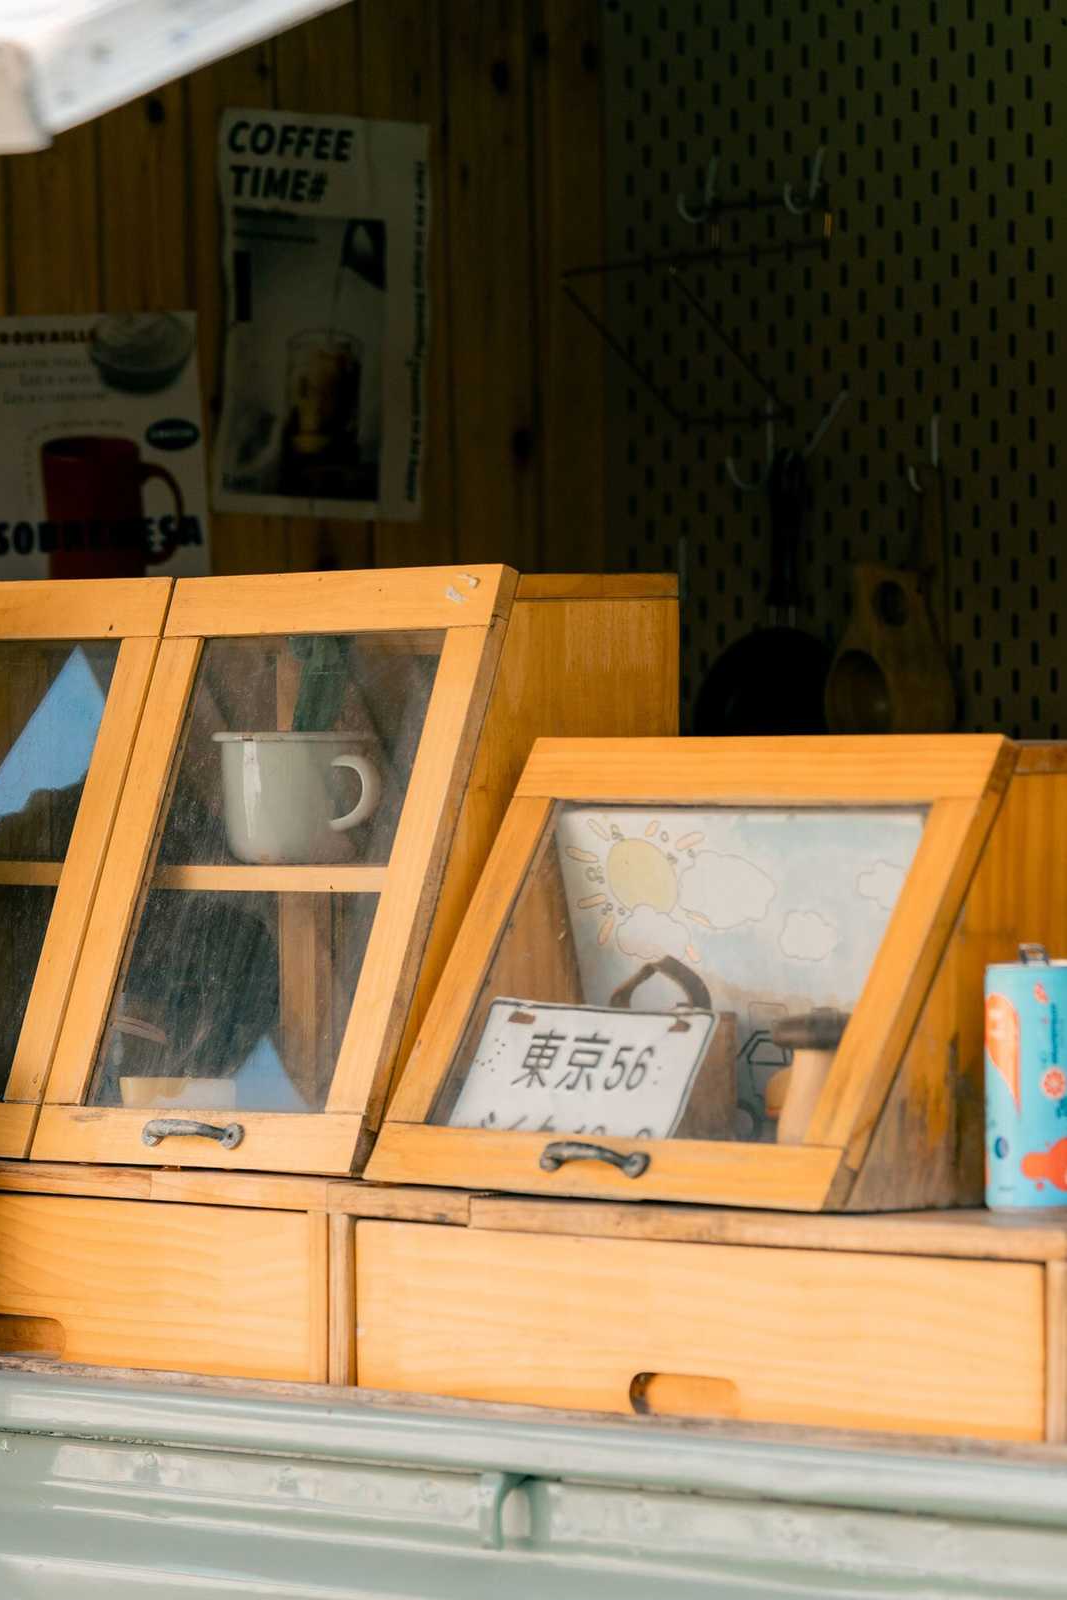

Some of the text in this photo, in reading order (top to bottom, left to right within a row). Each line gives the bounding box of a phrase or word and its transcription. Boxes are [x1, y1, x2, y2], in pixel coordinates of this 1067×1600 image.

[228, 119, 354, 161] COFFEE
[229, 164, 328, 202] TIME#
[509, 1029, 656, 1092] 東京56
